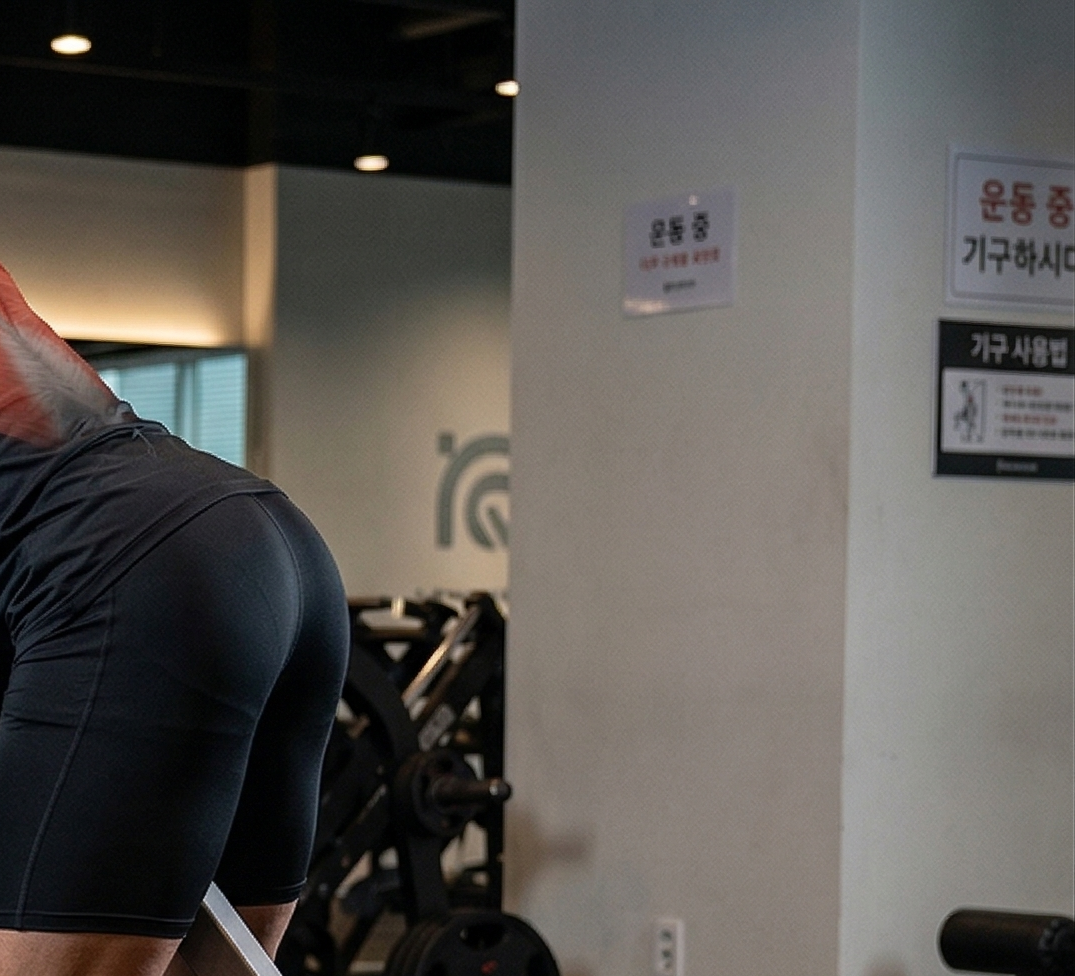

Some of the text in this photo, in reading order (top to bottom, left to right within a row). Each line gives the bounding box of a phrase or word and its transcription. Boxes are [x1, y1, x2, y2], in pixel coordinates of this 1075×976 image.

[980, 179, 1074, 229] 운동 중
[649, 210, 710, 249] 운동 중
[970, 331, 1009, 364] 기구
